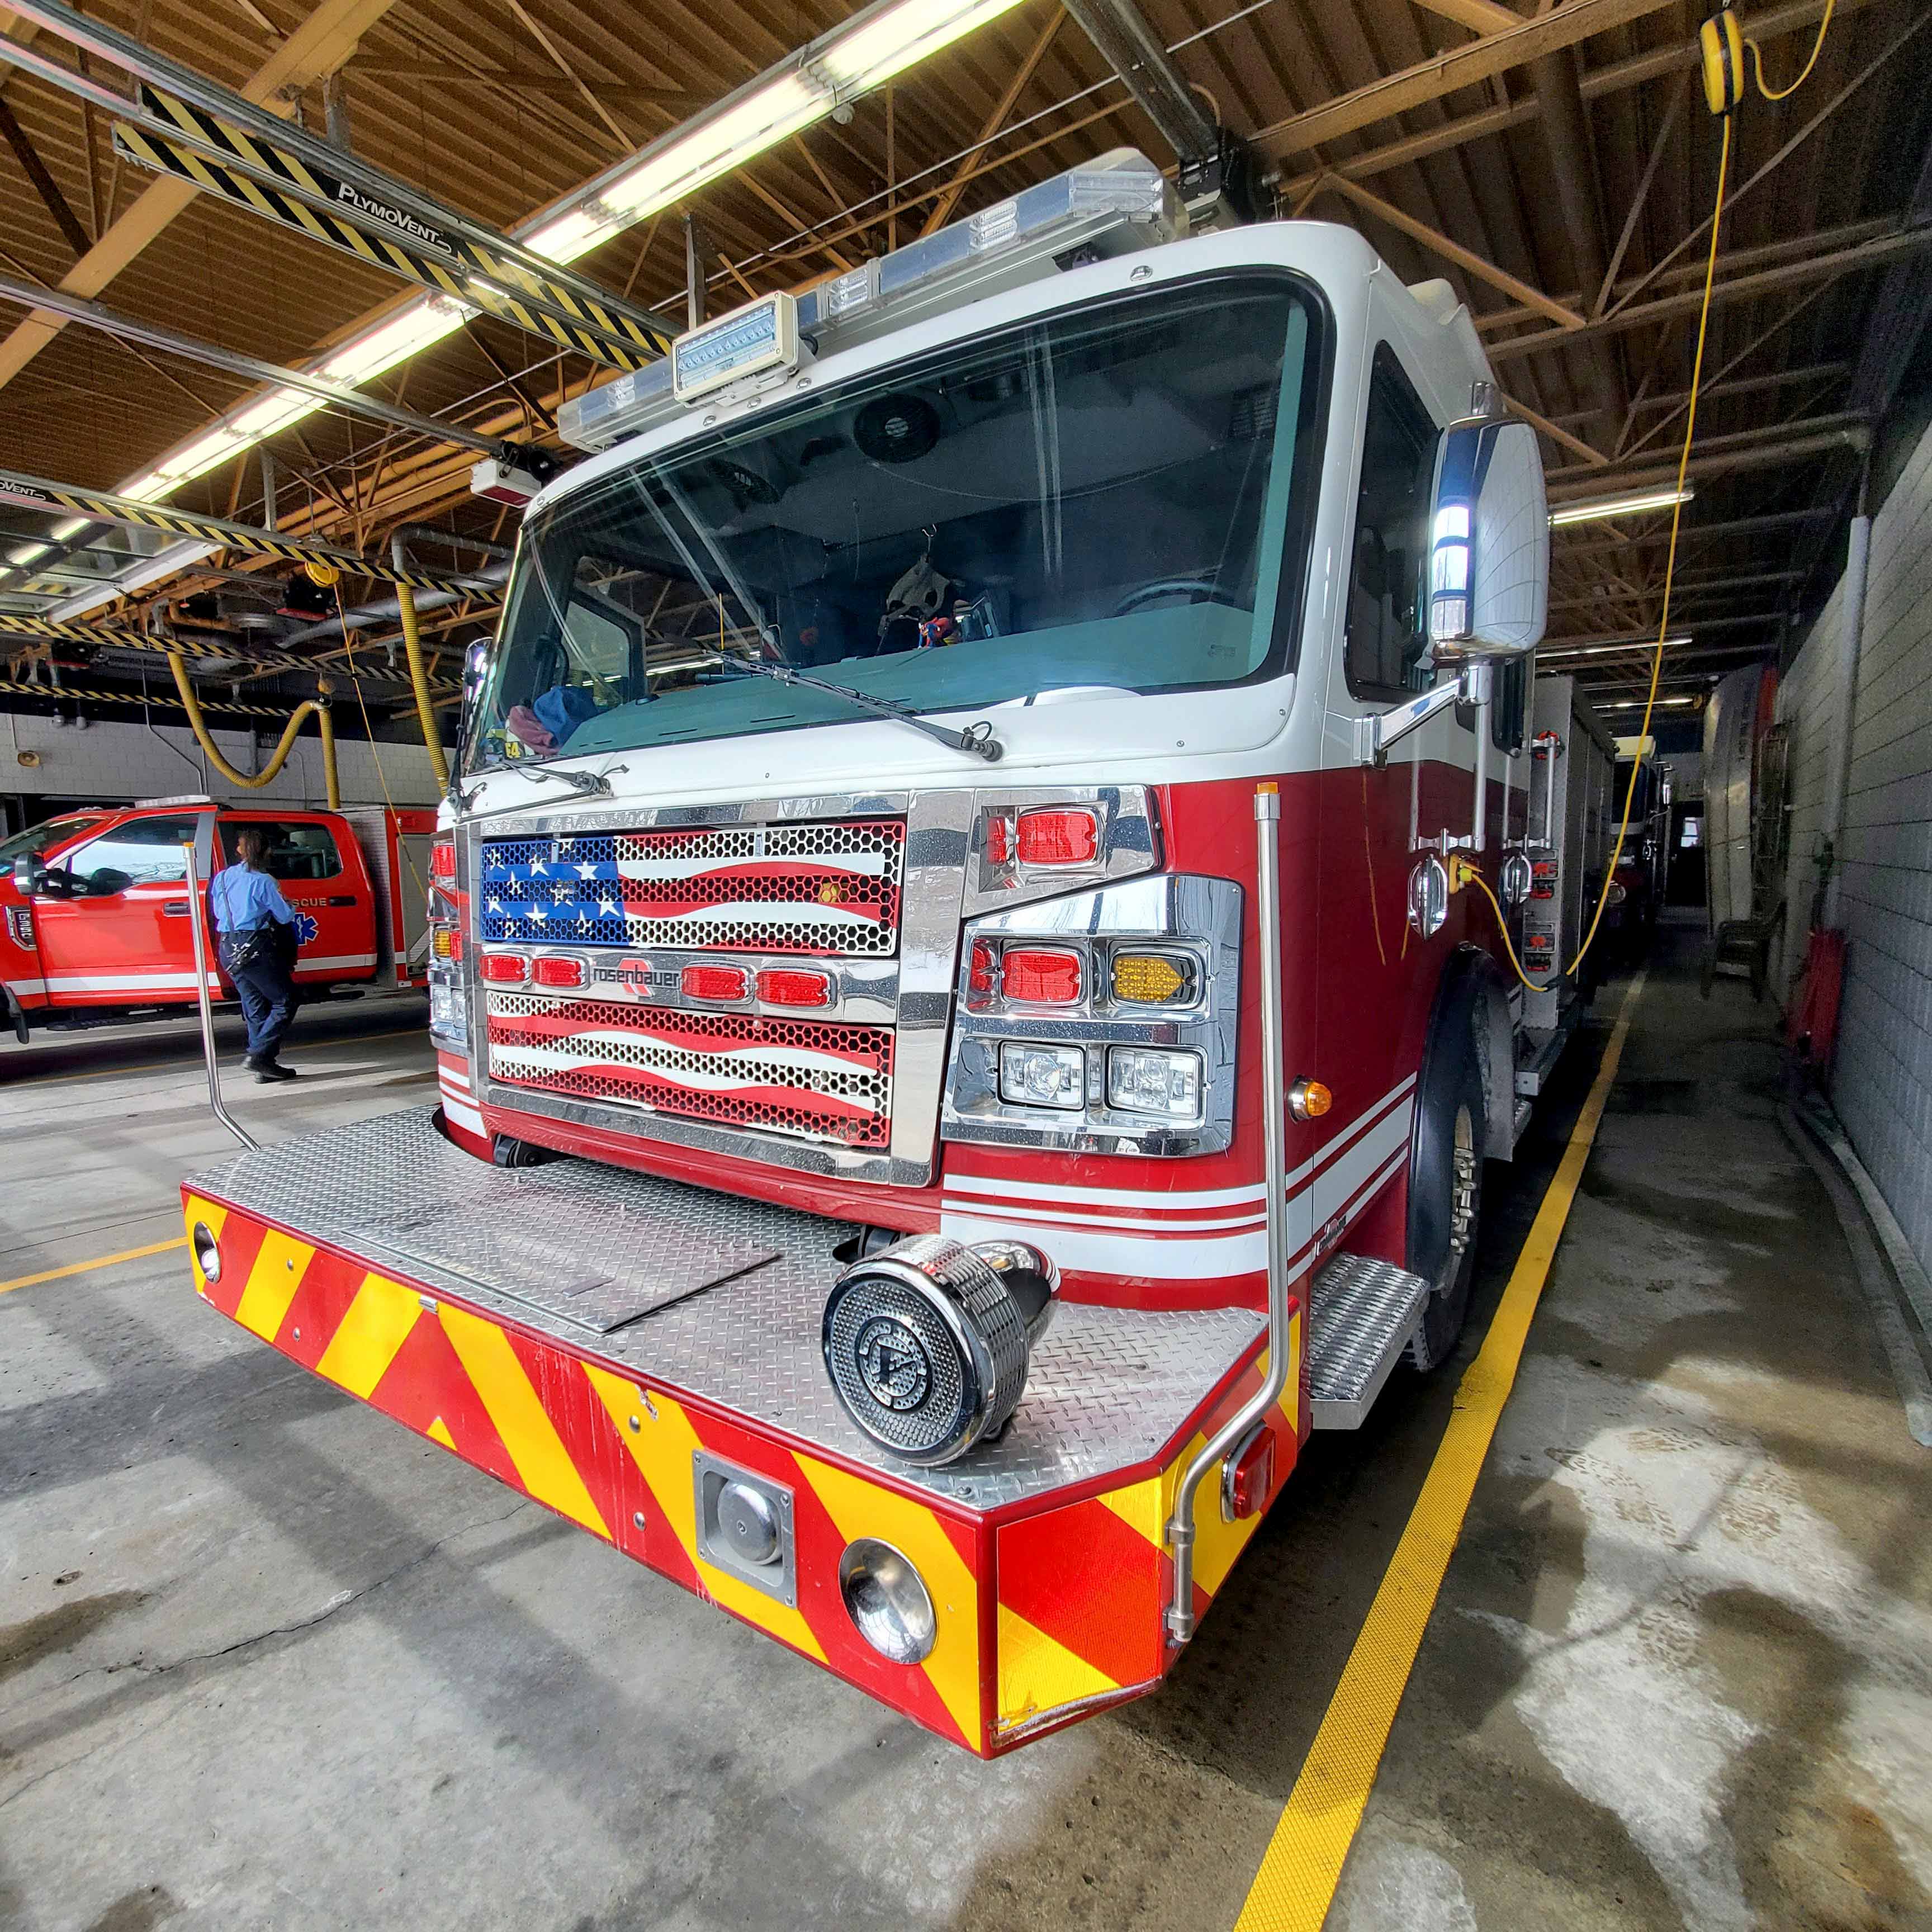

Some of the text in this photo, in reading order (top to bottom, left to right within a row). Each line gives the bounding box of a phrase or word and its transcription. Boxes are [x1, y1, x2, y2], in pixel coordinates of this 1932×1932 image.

[0, 481, 36, 496] OVENT
[292, 898, 327, 907] SCUE
[594, 964, 679, 987] rosenbauer
